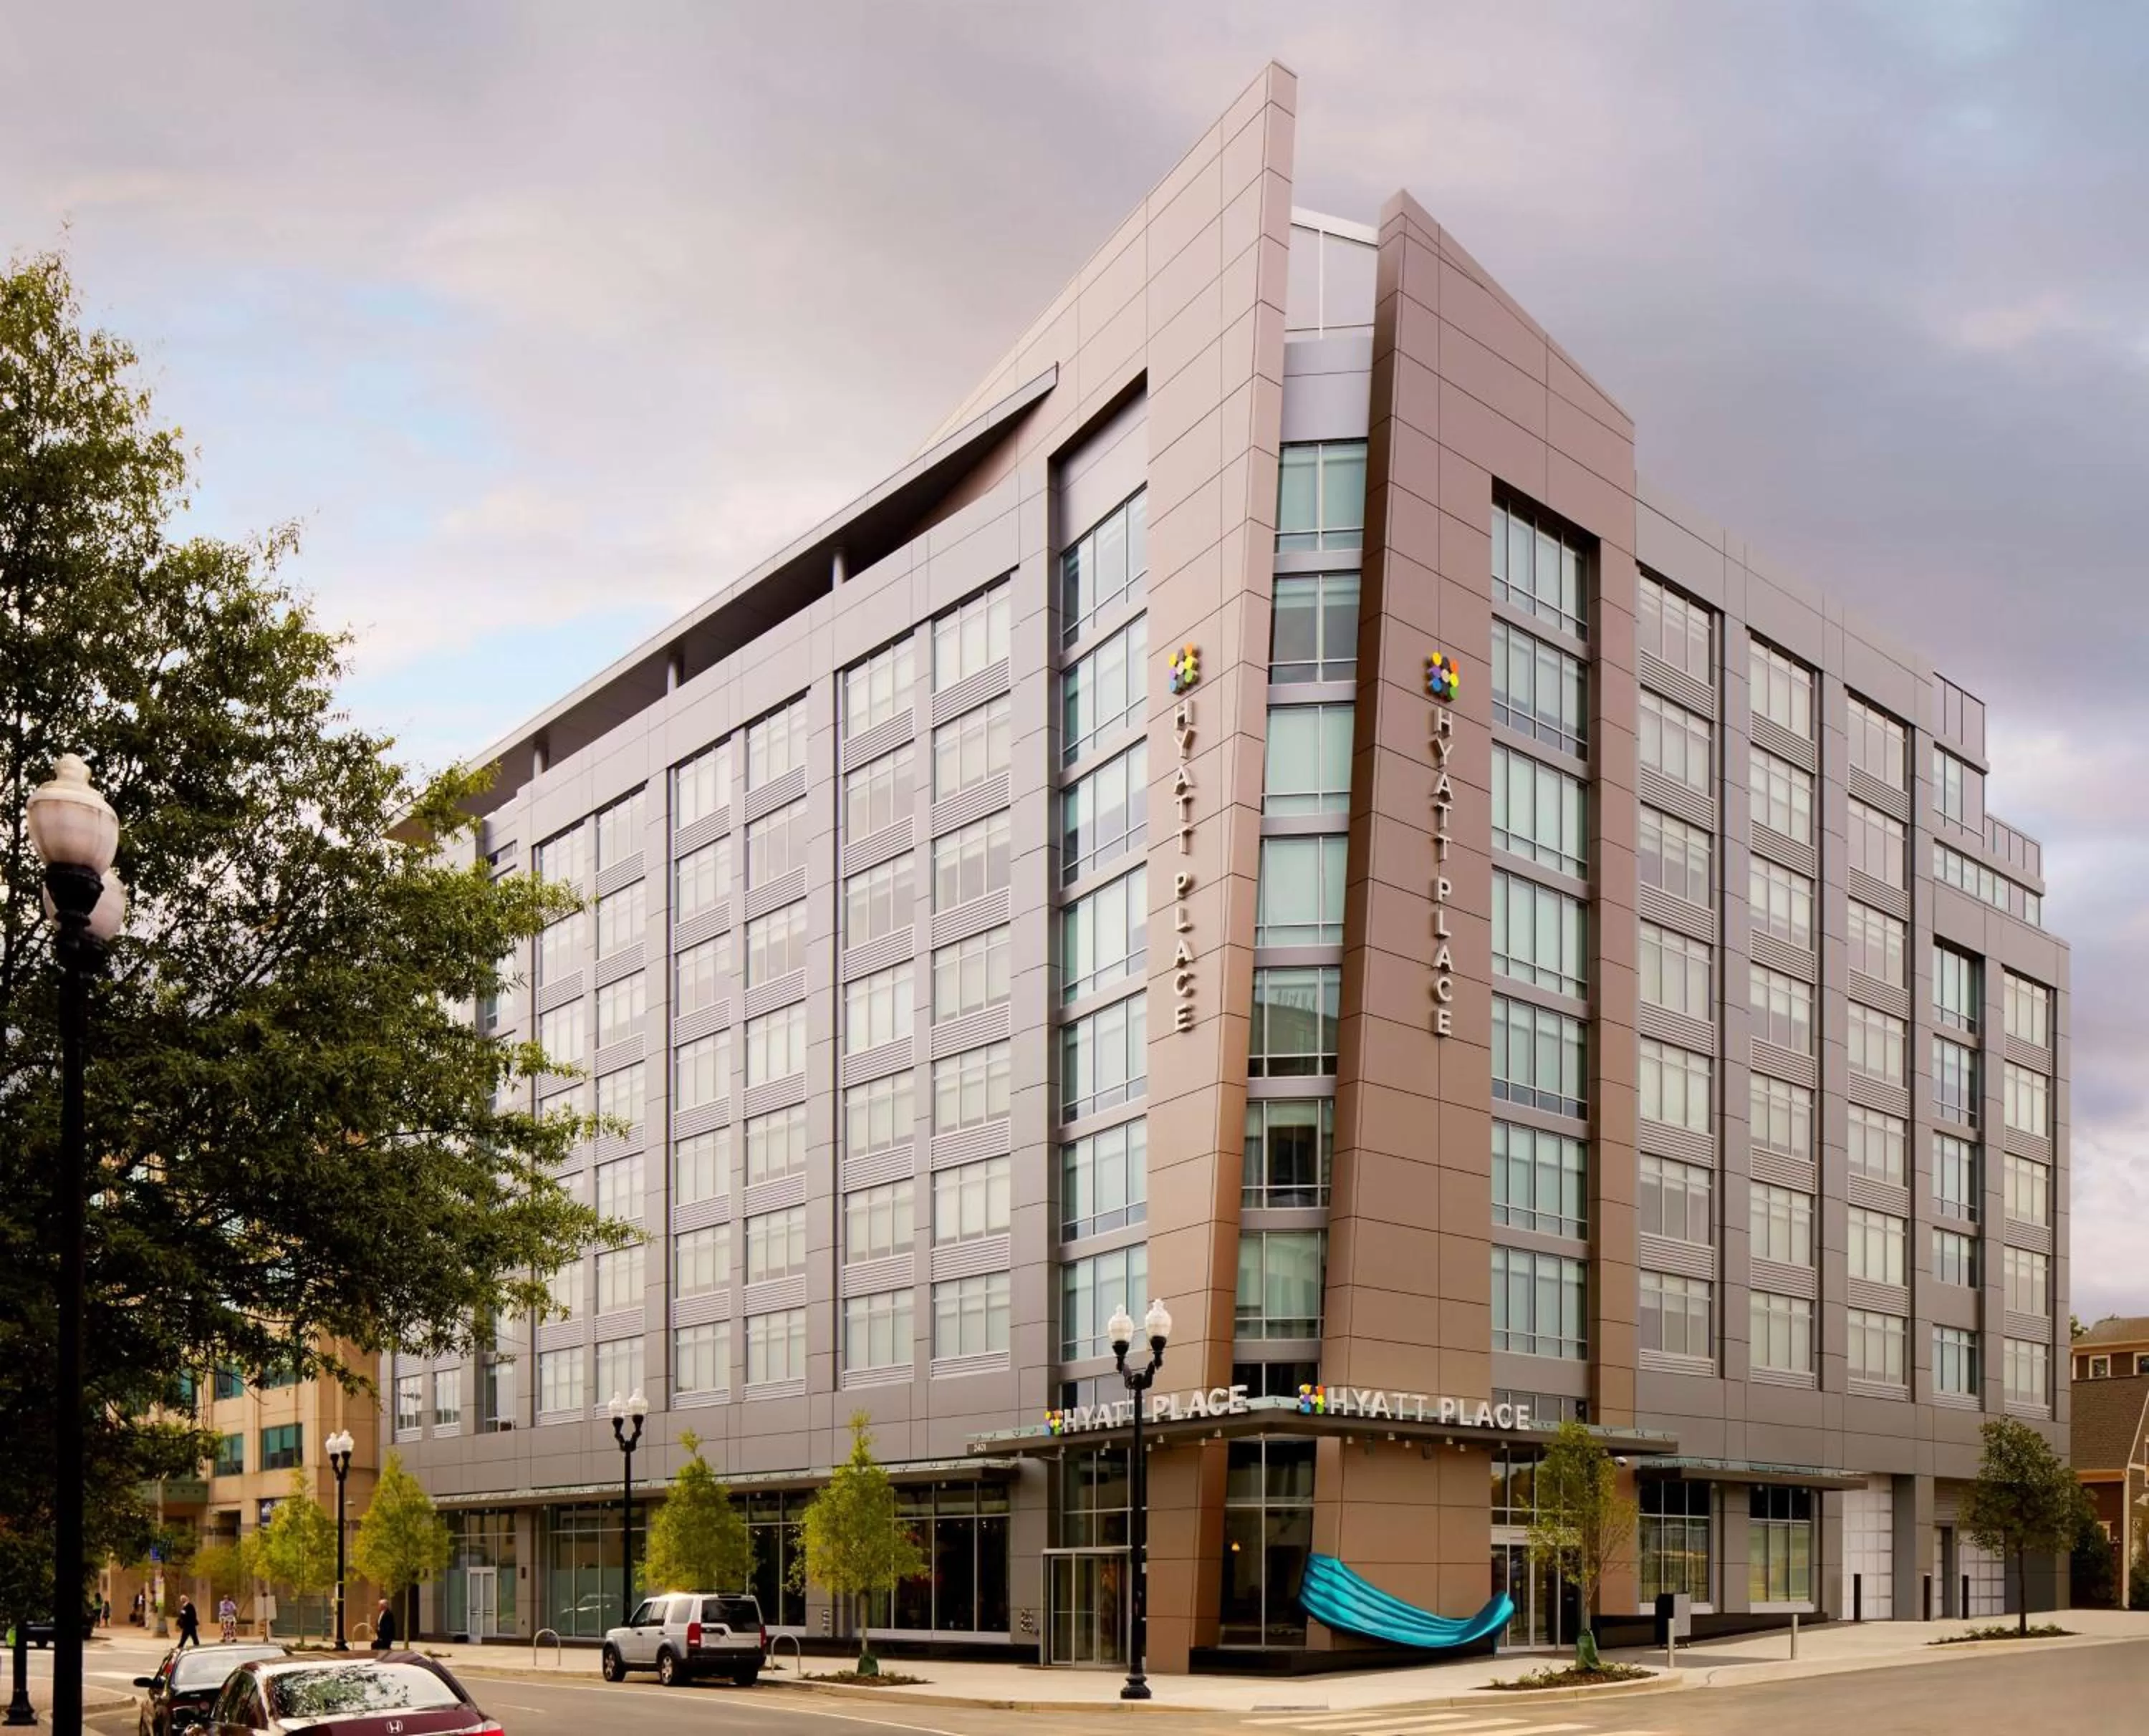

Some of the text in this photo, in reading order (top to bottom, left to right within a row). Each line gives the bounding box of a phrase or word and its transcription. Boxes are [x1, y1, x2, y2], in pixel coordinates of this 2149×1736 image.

[1173, 699, 1194, 1031] HYATT PLACE
[1432, 707, 1453, 1036] HYATT PLACE
[1152, 1384, 1248, 1423] PLACE
[1327, 1387, 1530, 1430] HYATT PLACE
